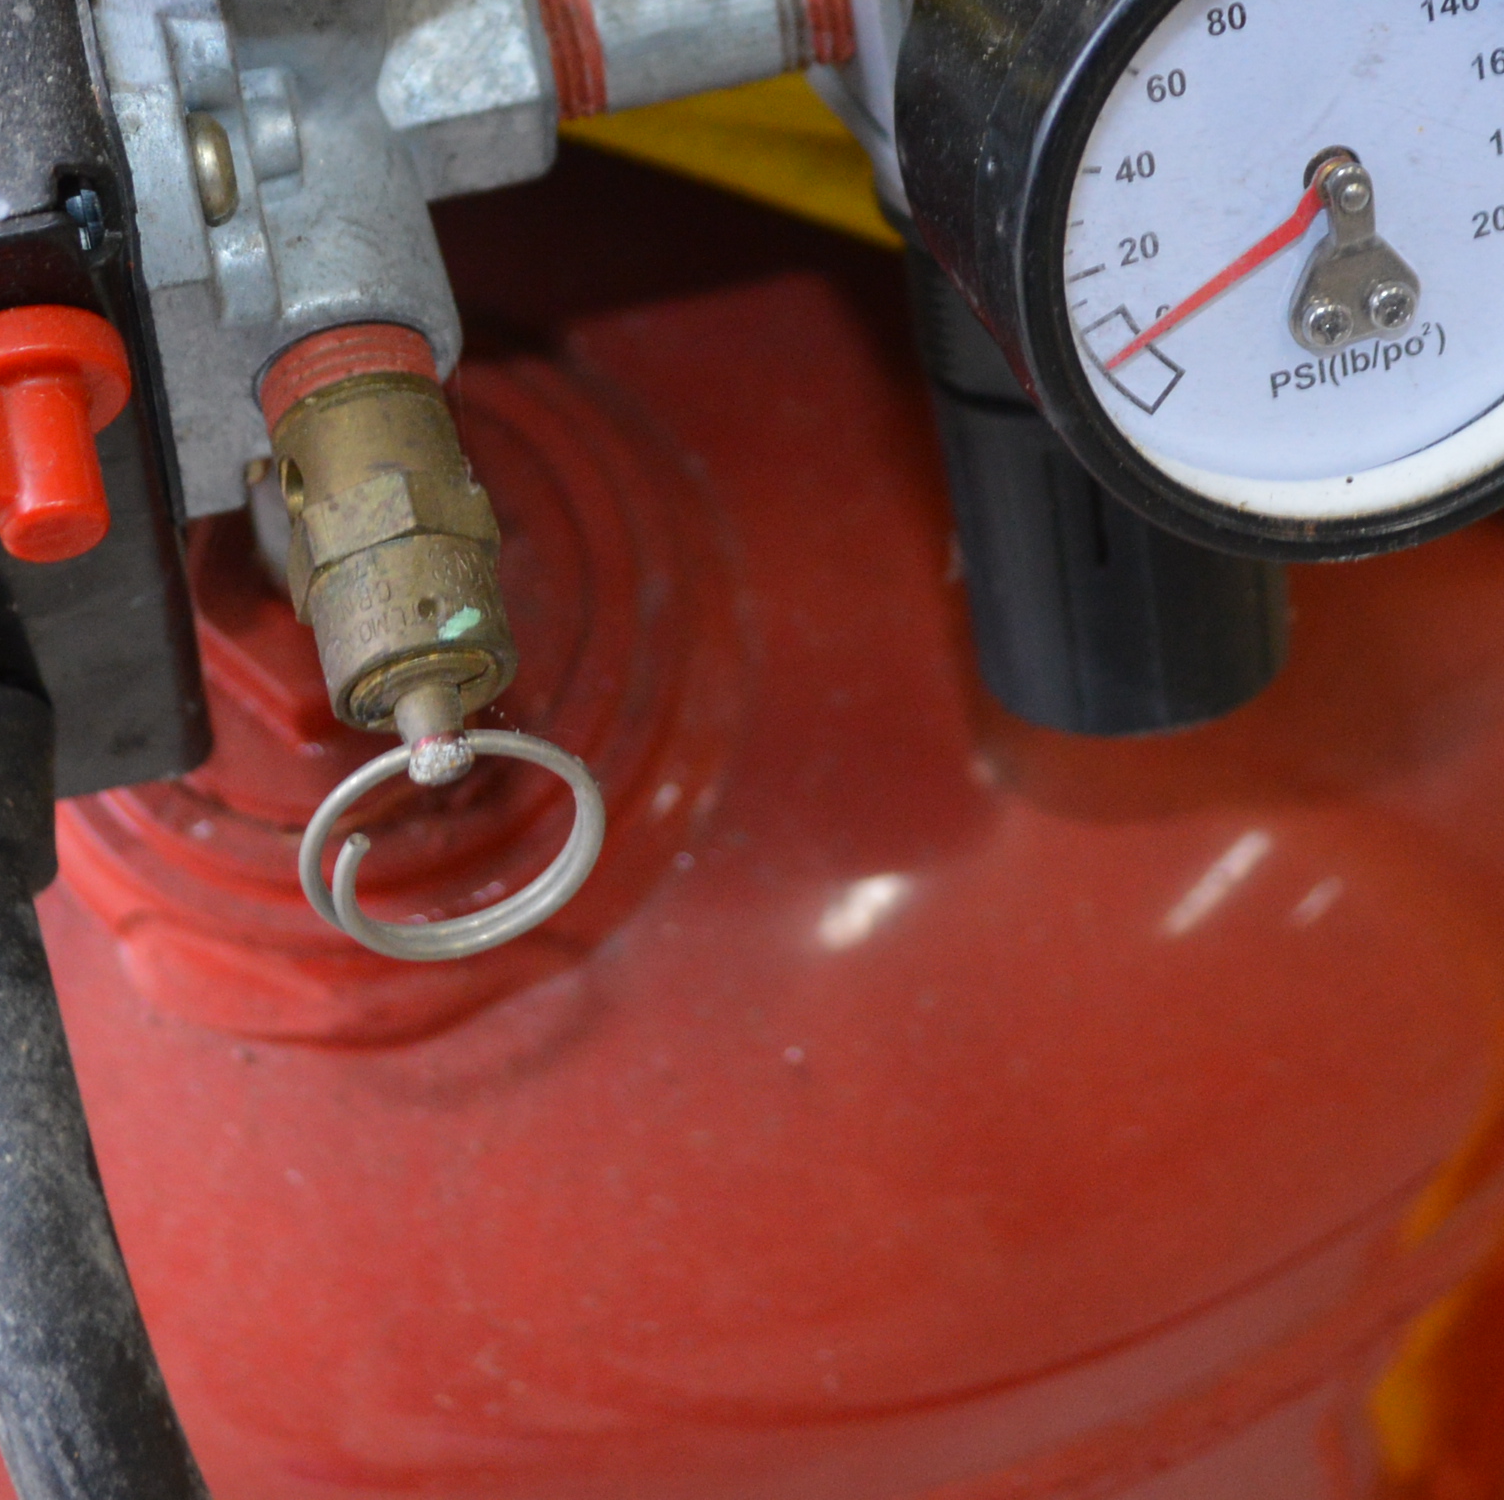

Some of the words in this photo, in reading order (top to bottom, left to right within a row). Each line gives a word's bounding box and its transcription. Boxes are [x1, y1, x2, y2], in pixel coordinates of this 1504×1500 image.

[1206, 1, 1248, 38] 80
[1145, 67, 1188, 104] 60
[1114, 150, 1156, 184] 40
[1118, 231, 1160, 267] 20
